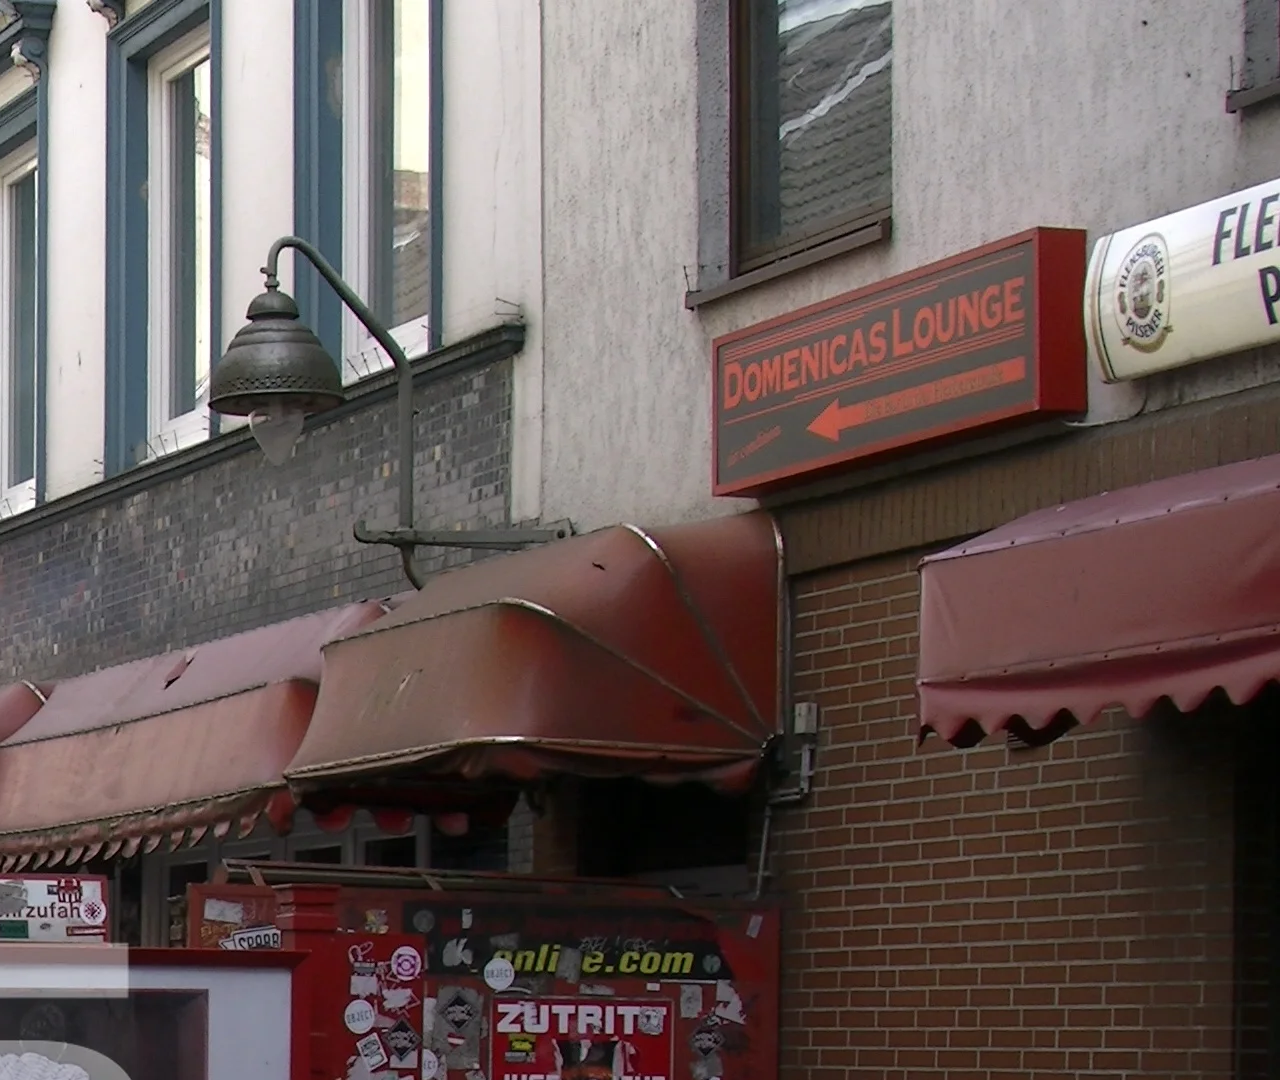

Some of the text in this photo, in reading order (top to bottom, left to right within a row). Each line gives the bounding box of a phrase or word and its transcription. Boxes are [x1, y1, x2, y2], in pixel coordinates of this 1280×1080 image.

[1212, 193, 1280, 266] FLE
[723, 320, 887, 411] DOMENICAS
[893, 276, 1026, 357] LOUNGE
[1126, 308, 1163, 339] PILSENER
[497, 1003, 667, 1035] ZUTRIT
